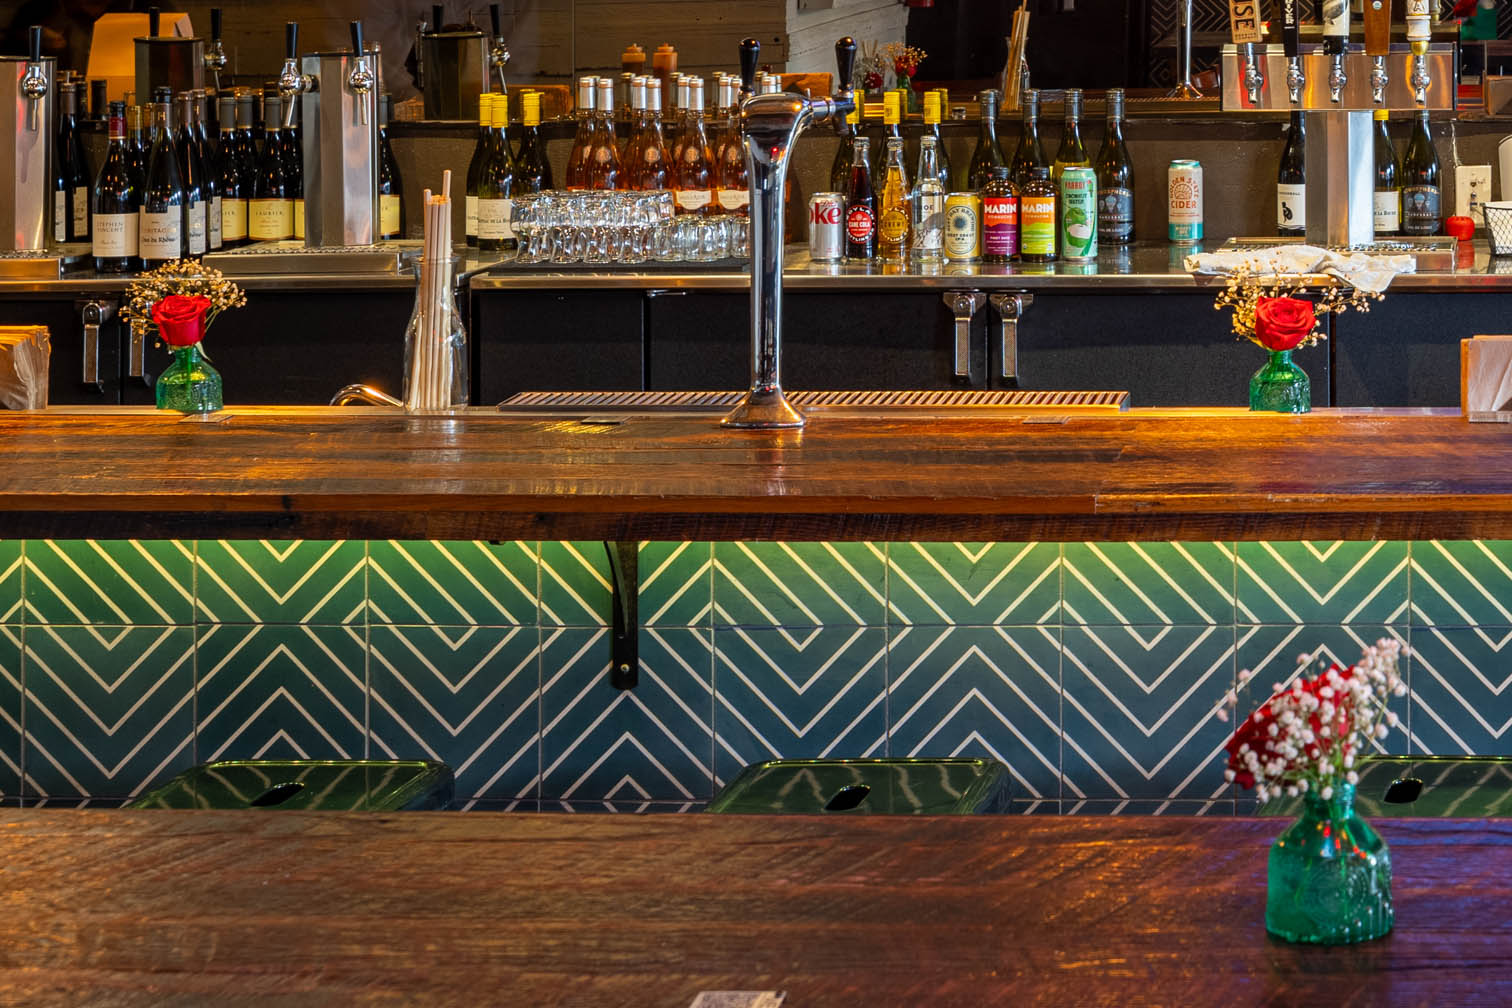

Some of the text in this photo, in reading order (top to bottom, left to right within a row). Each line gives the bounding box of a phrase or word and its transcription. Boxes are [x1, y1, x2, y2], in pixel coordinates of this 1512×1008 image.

[984, 203, 1017, 214] MARIN
[1022, 202, 1054, 213] MARIN
[1170, 200, 1197, 209] CIDER
